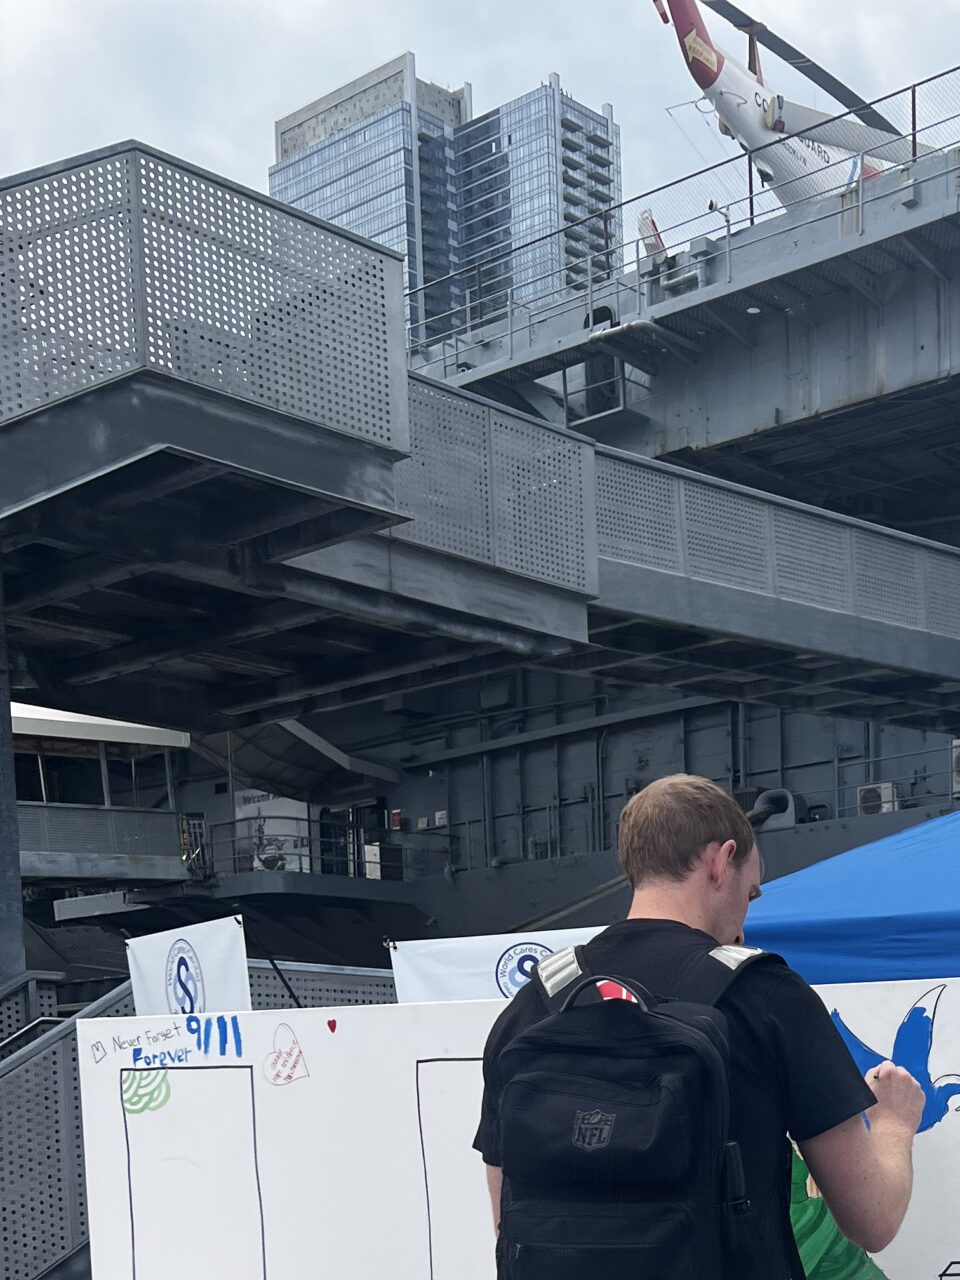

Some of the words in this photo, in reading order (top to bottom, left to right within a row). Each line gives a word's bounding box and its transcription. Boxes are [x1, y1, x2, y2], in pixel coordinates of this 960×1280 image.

[500, 953, 515, 979] World
[513, 946, 538, 956] Cares
[112, 1034, 142, 1053] Never
[144, 1021, 182, 1044] Forget
[132, 1047, 192, 1068] Forever
[575, 1125, 610, 1147] NFL
